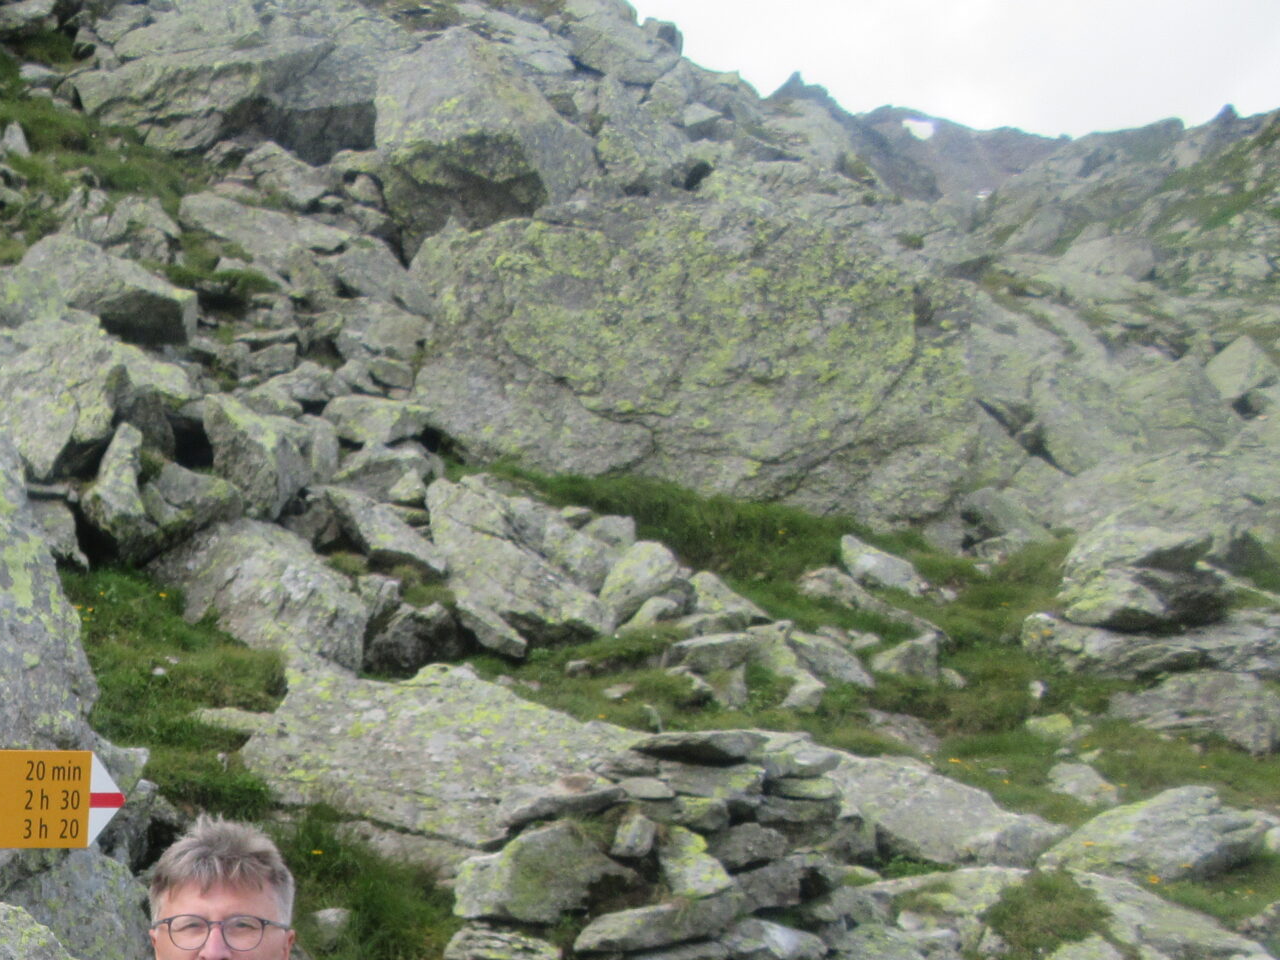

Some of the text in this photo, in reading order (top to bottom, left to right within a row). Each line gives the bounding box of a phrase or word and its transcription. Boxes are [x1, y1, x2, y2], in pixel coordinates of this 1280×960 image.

[25, 759, 46, 782] 20
[51, 760, 82, 781] min
[24, 789, 34, 811] 2
[40, 788, 49, 810] h
[60, 789, 81, 811] 30
[23, 818, 33, 840] 3
[38, 817, 48, 839] h
[59, 818, 79, 840] 20
